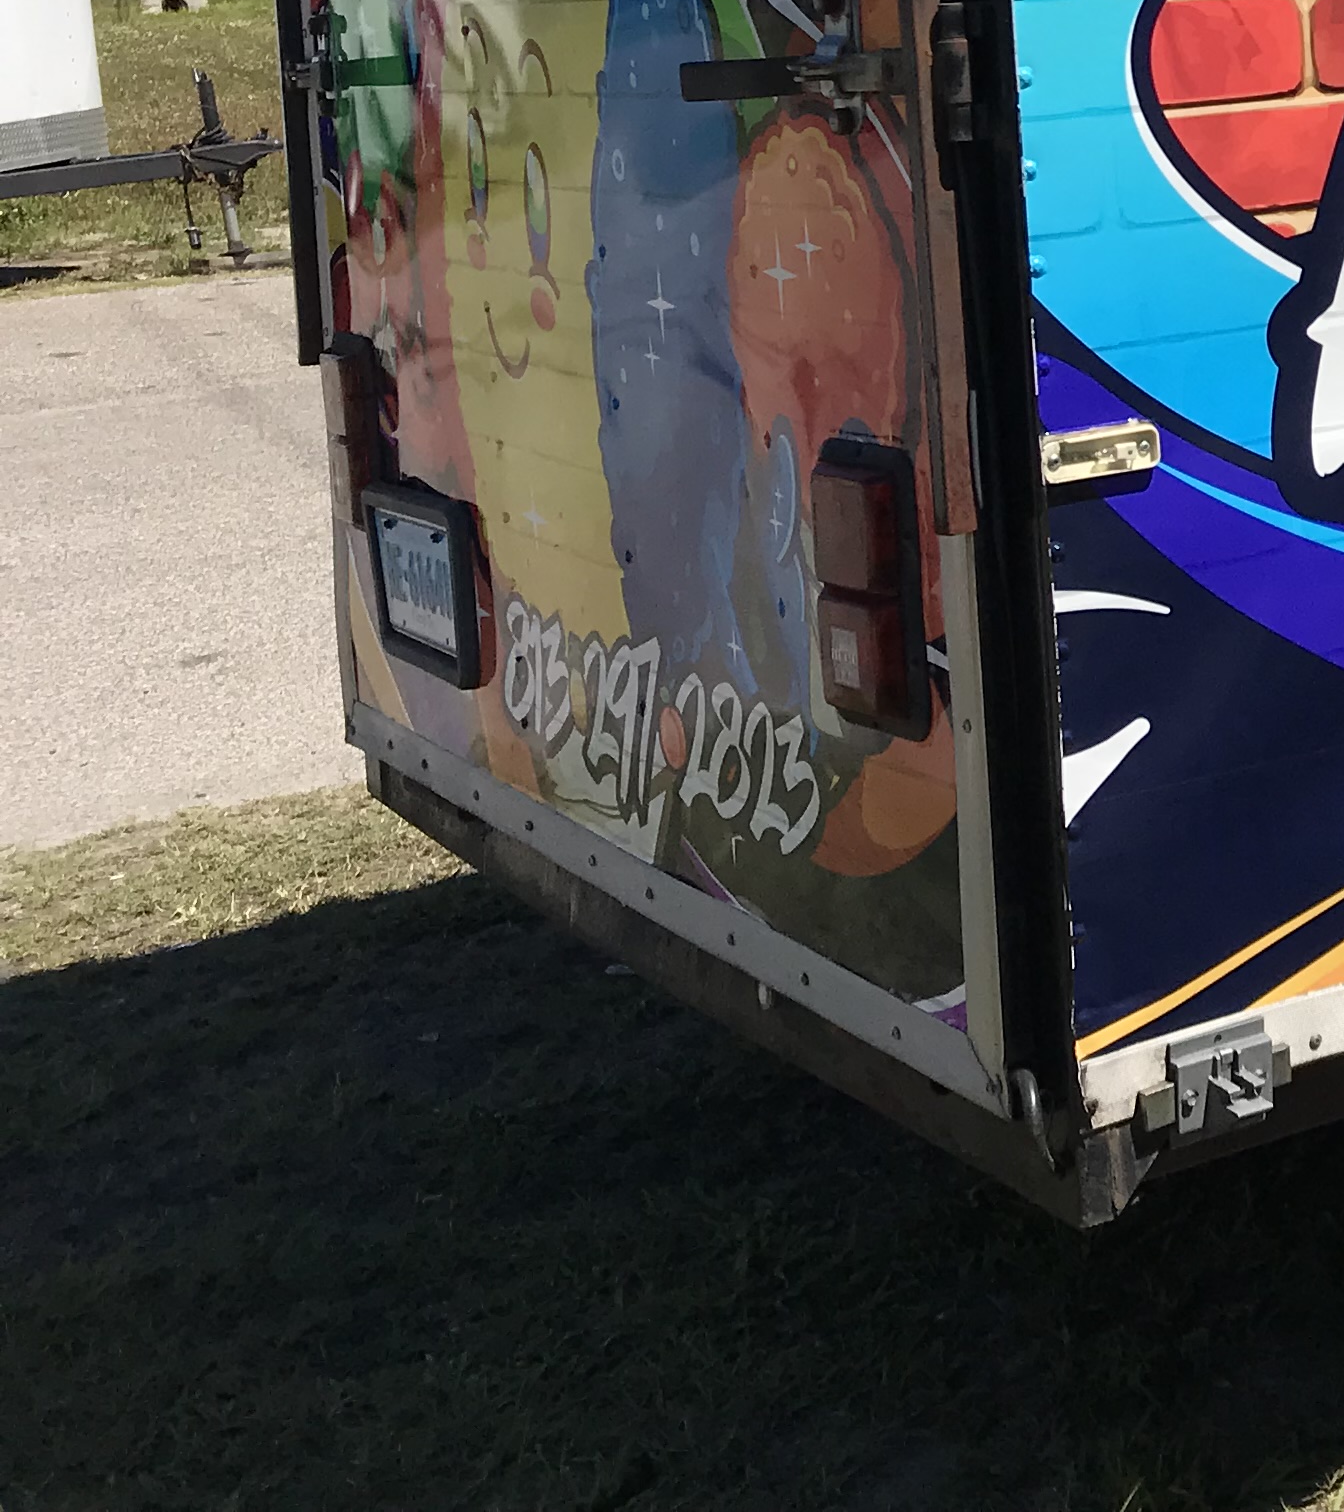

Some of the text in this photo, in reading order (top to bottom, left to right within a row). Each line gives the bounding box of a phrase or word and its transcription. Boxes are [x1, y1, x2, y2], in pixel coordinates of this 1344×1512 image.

[503, 600, 822, 857] 813 297 2823
